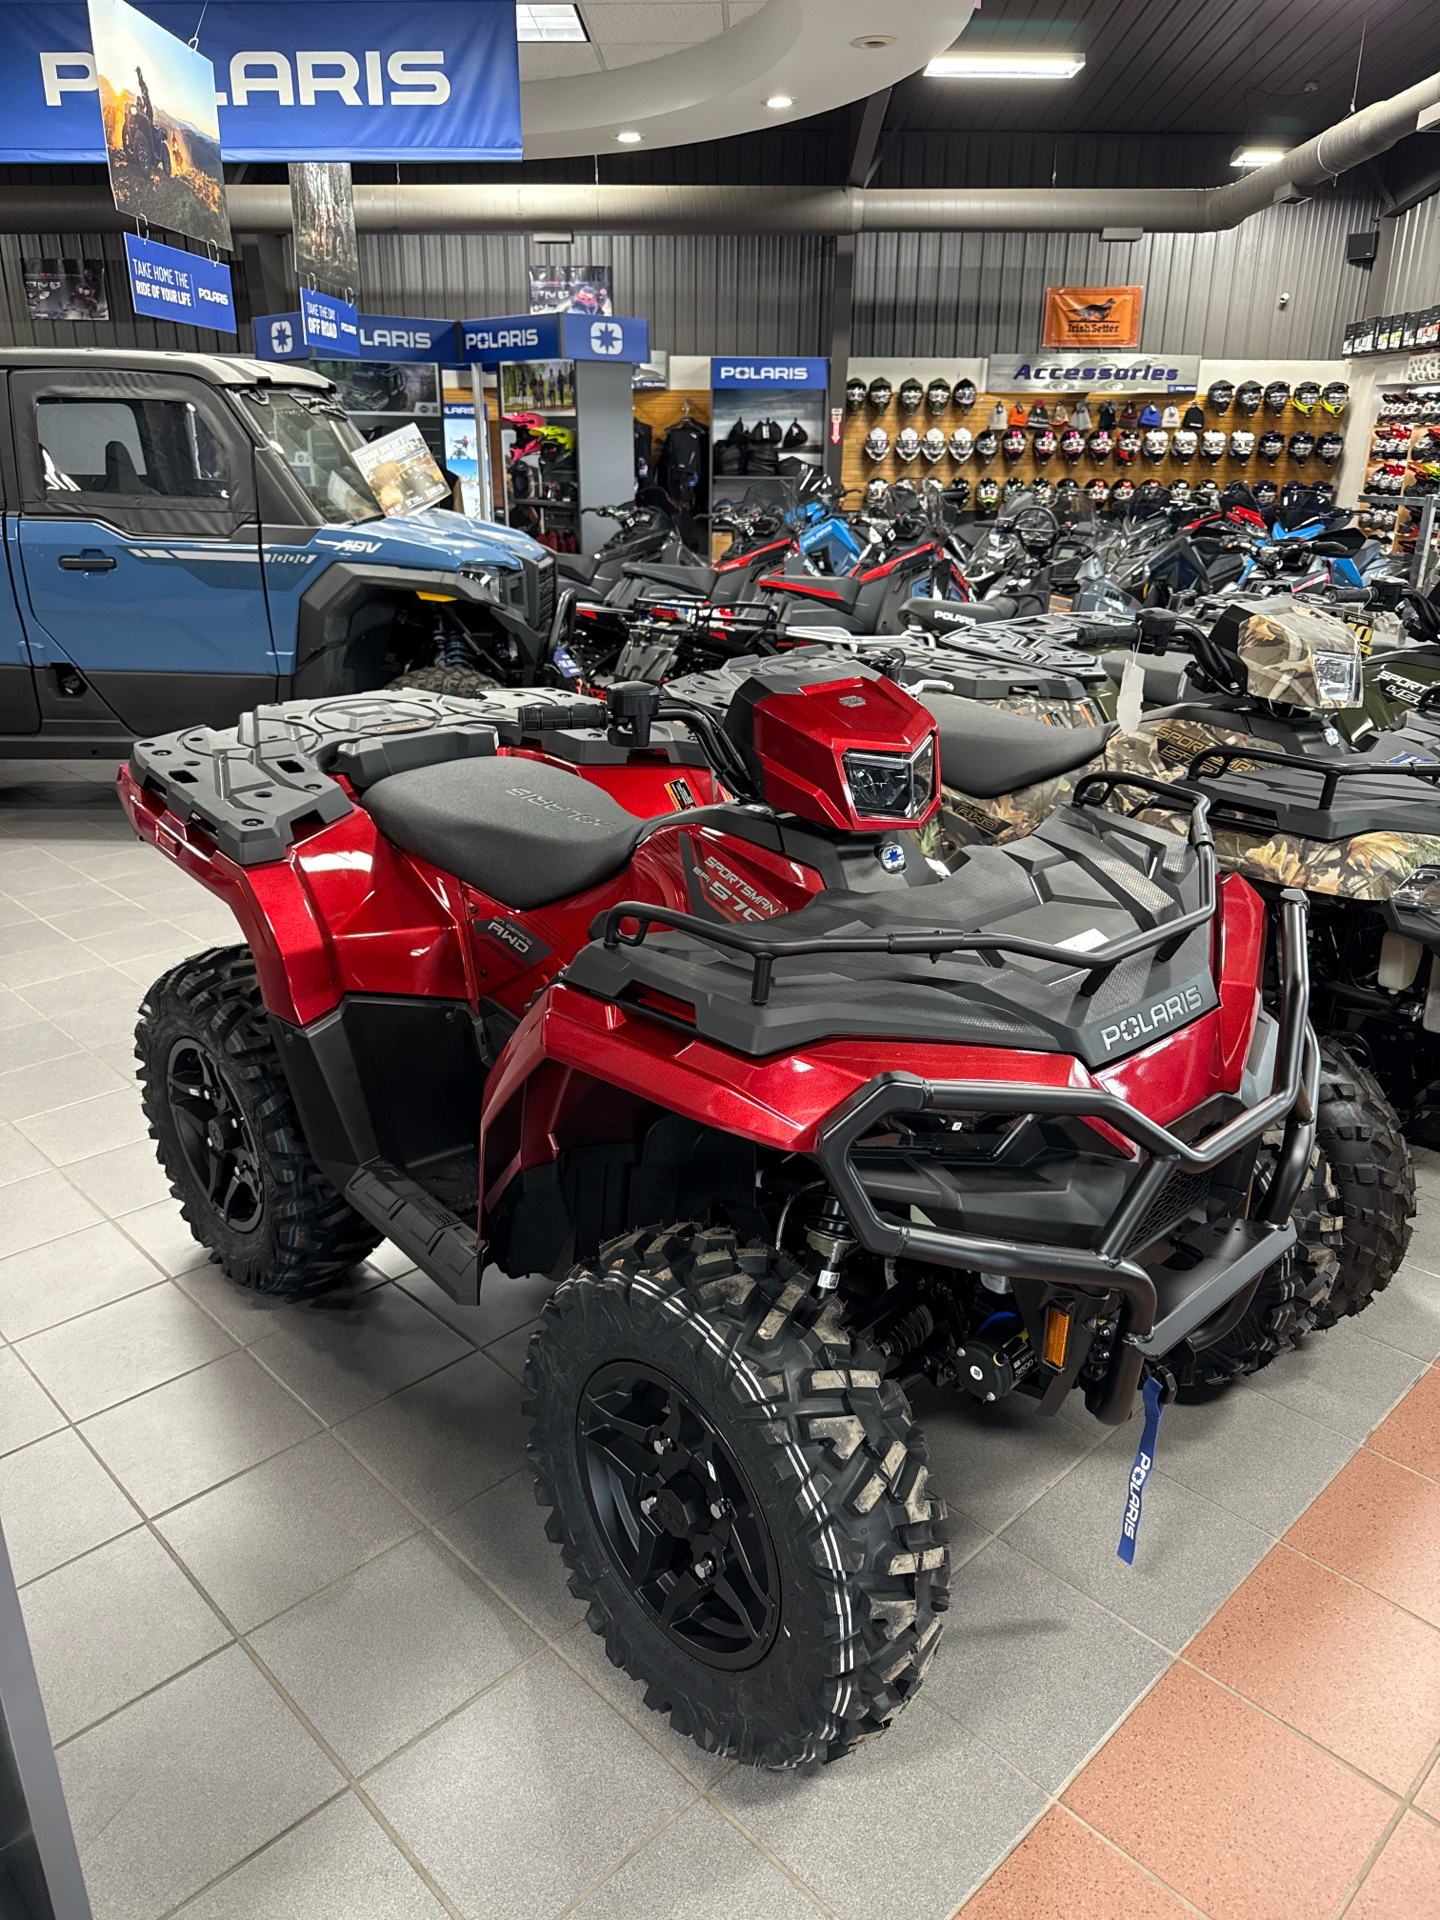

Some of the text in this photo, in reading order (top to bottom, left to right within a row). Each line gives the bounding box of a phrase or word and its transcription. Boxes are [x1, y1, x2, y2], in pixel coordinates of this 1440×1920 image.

[40, 50, 451, 106] PARIS
[132, 258, 189, 289] TAKE HOME THE
[135, 280, 192, 307] RIDE OF YOUR LIFE
[198, 287, 229, 306] POLARIS
[306, 302, 319, 317] TAKE
[308, 316, 338, 339] OFF ROAD
[360, 328, 431, 349] LARIS
[1067, 323, 1119, 333] Irish Setter
[465, 328, 539, 350] POLARIS
[720, 367, 808, 380] POLARIS
[1013, 364, 1178, 381] Accessories
[934, 610, 977, 626] POLARIS
[1386, 685, 1422, 706] 45
[506, 787, 616, 828] POLARIS
[955, 805, 998, 831] AWD
[692, 866, 711, 883] EFI
[704, 856, 779, 915] SPORTSMAN
[487, 921, 529, 953] AWD
[1101, 985, 1203, 1051] POLARIS
[1124, 1451, 1151, 1540] POLARIS
